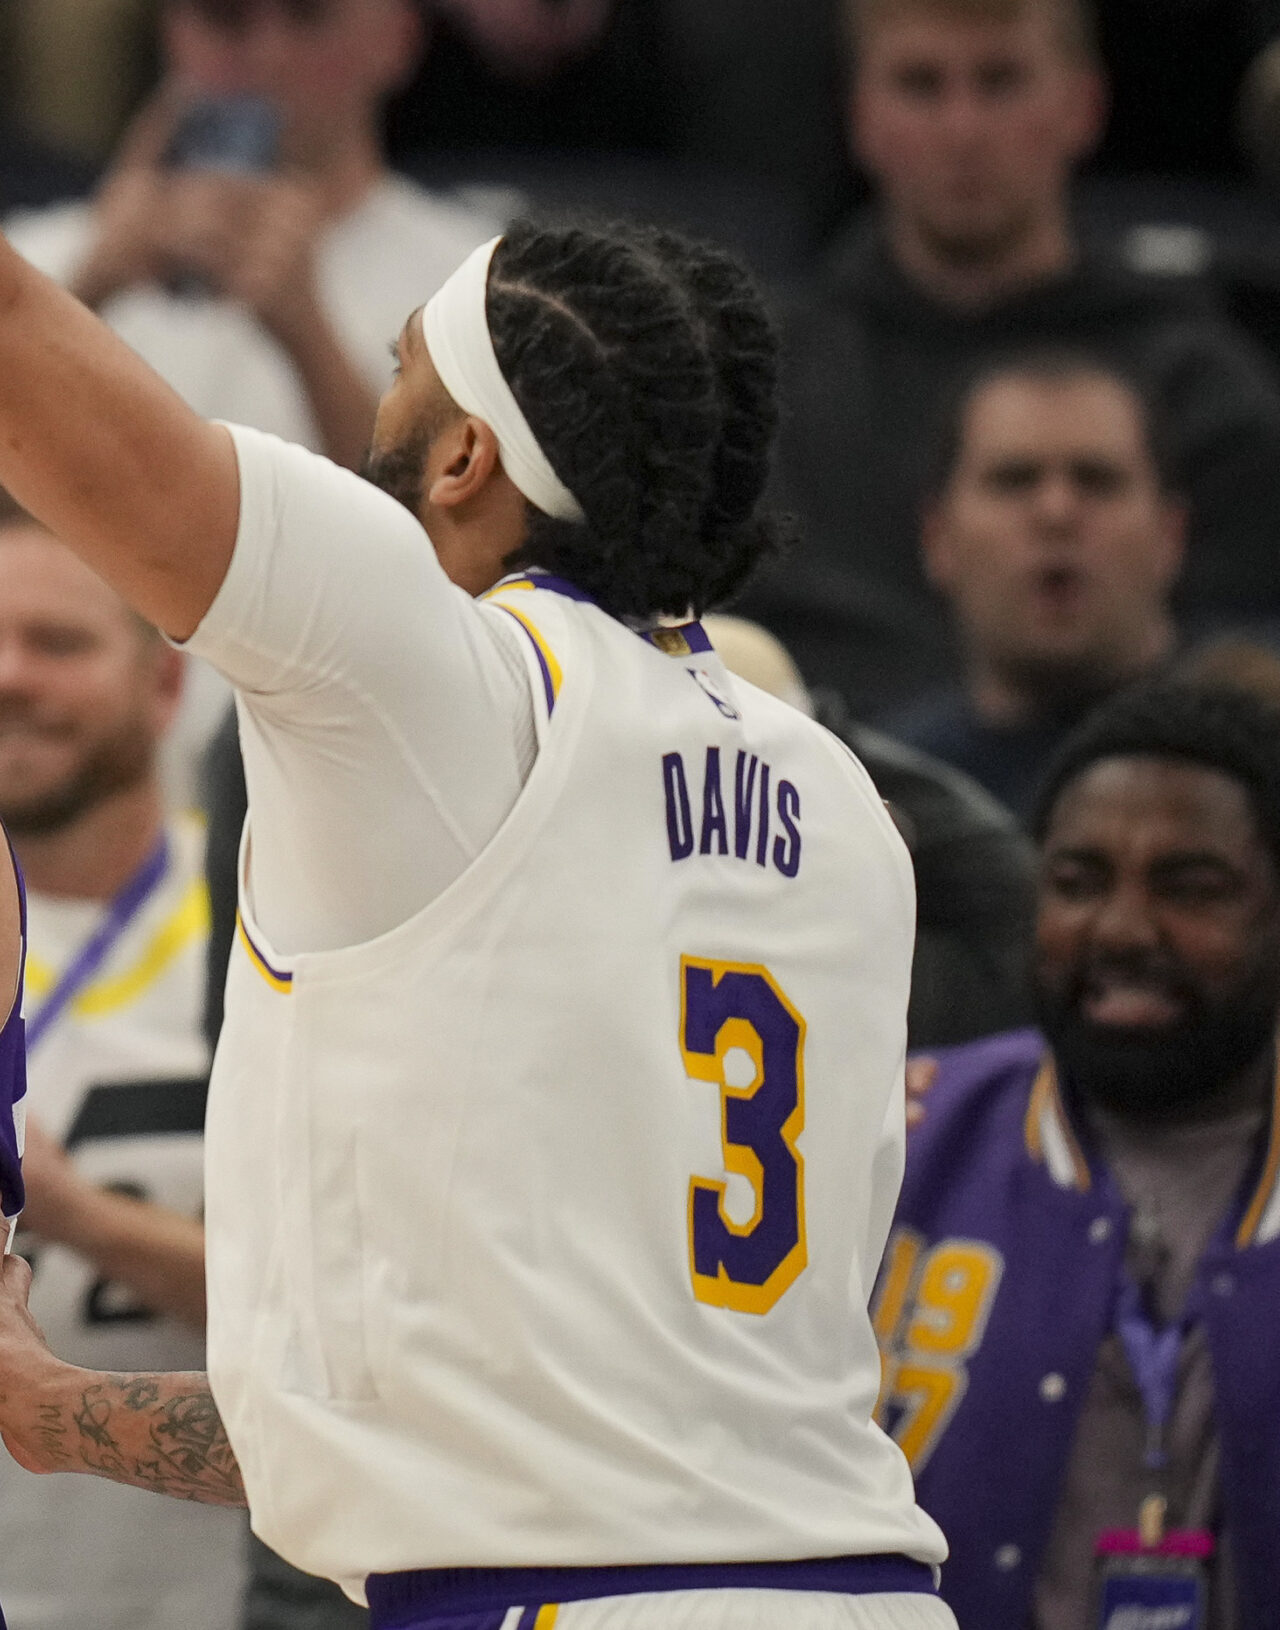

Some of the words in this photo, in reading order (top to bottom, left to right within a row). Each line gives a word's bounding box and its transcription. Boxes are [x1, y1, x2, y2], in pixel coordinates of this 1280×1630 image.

[663, 746, 801, 878] DAVIS
[679, 953, 807, 1316] 3
[874, 1232, 1004, 1358] 19
